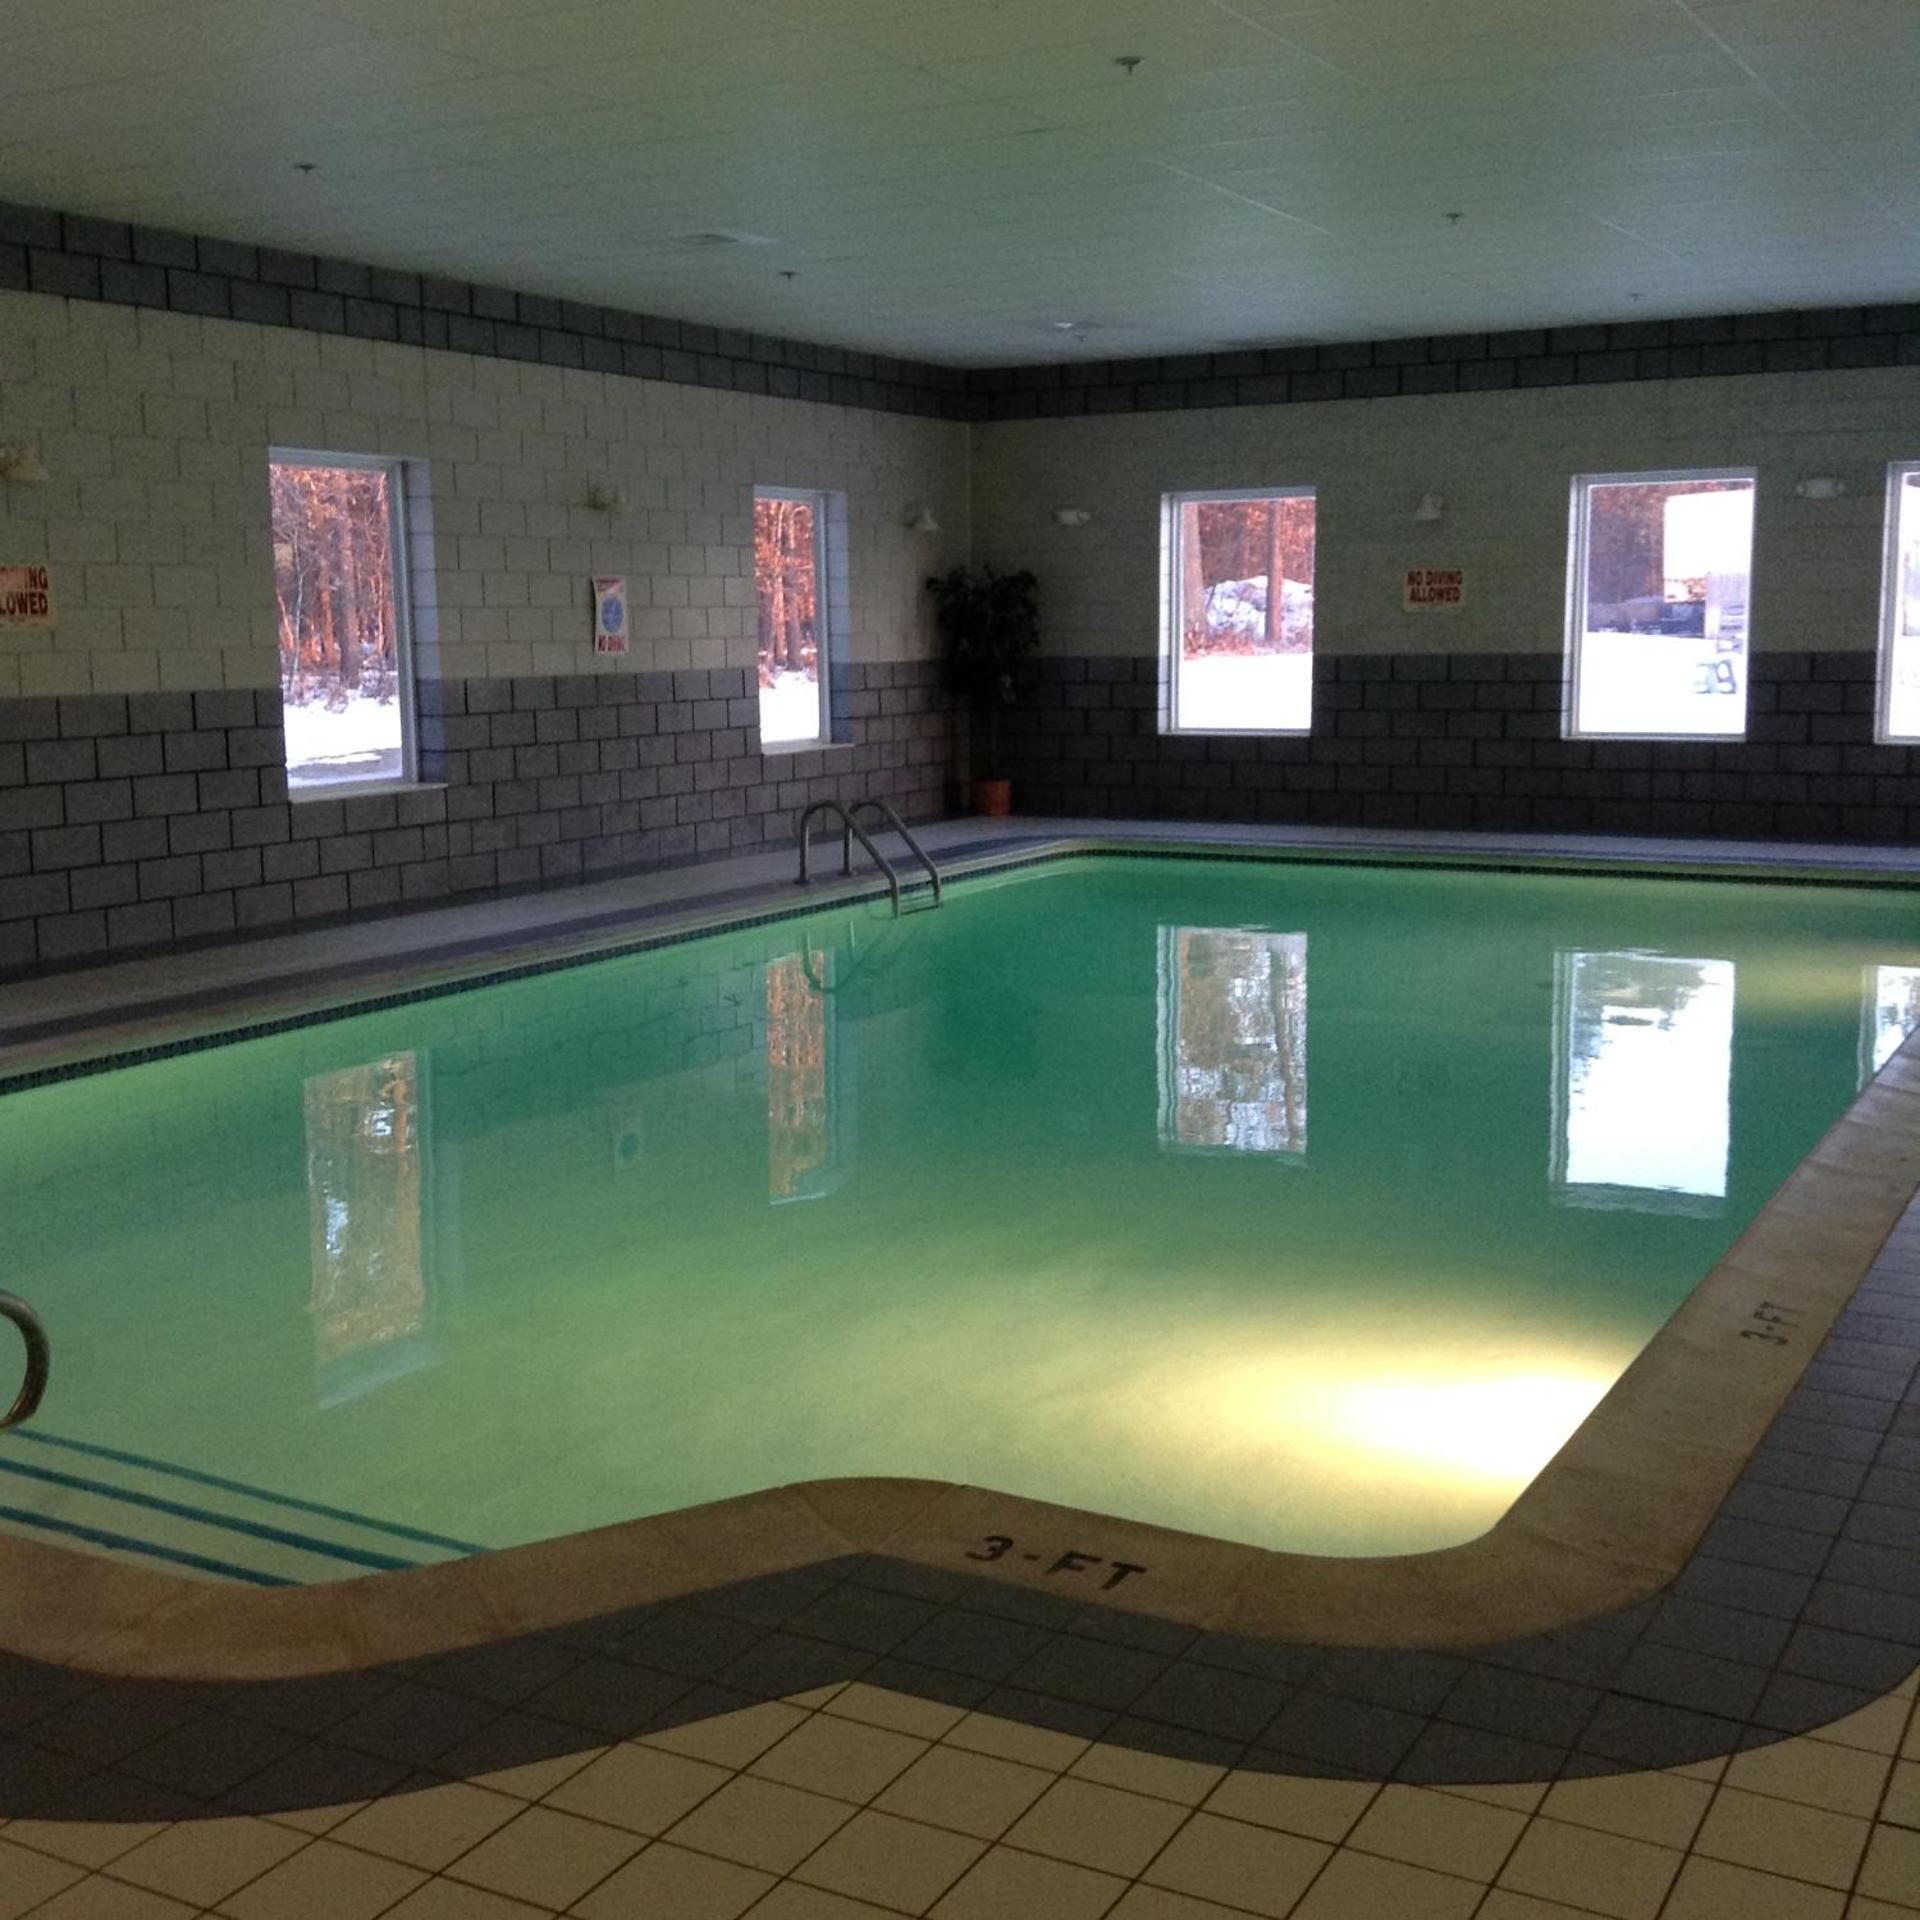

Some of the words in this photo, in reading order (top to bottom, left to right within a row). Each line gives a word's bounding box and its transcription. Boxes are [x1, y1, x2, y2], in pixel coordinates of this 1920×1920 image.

[1408, 571, 1423, 586] NO
[1410, 587, 1460, 602] ALLOWED
[964, 1535, 1148, 1590] 3-FT
